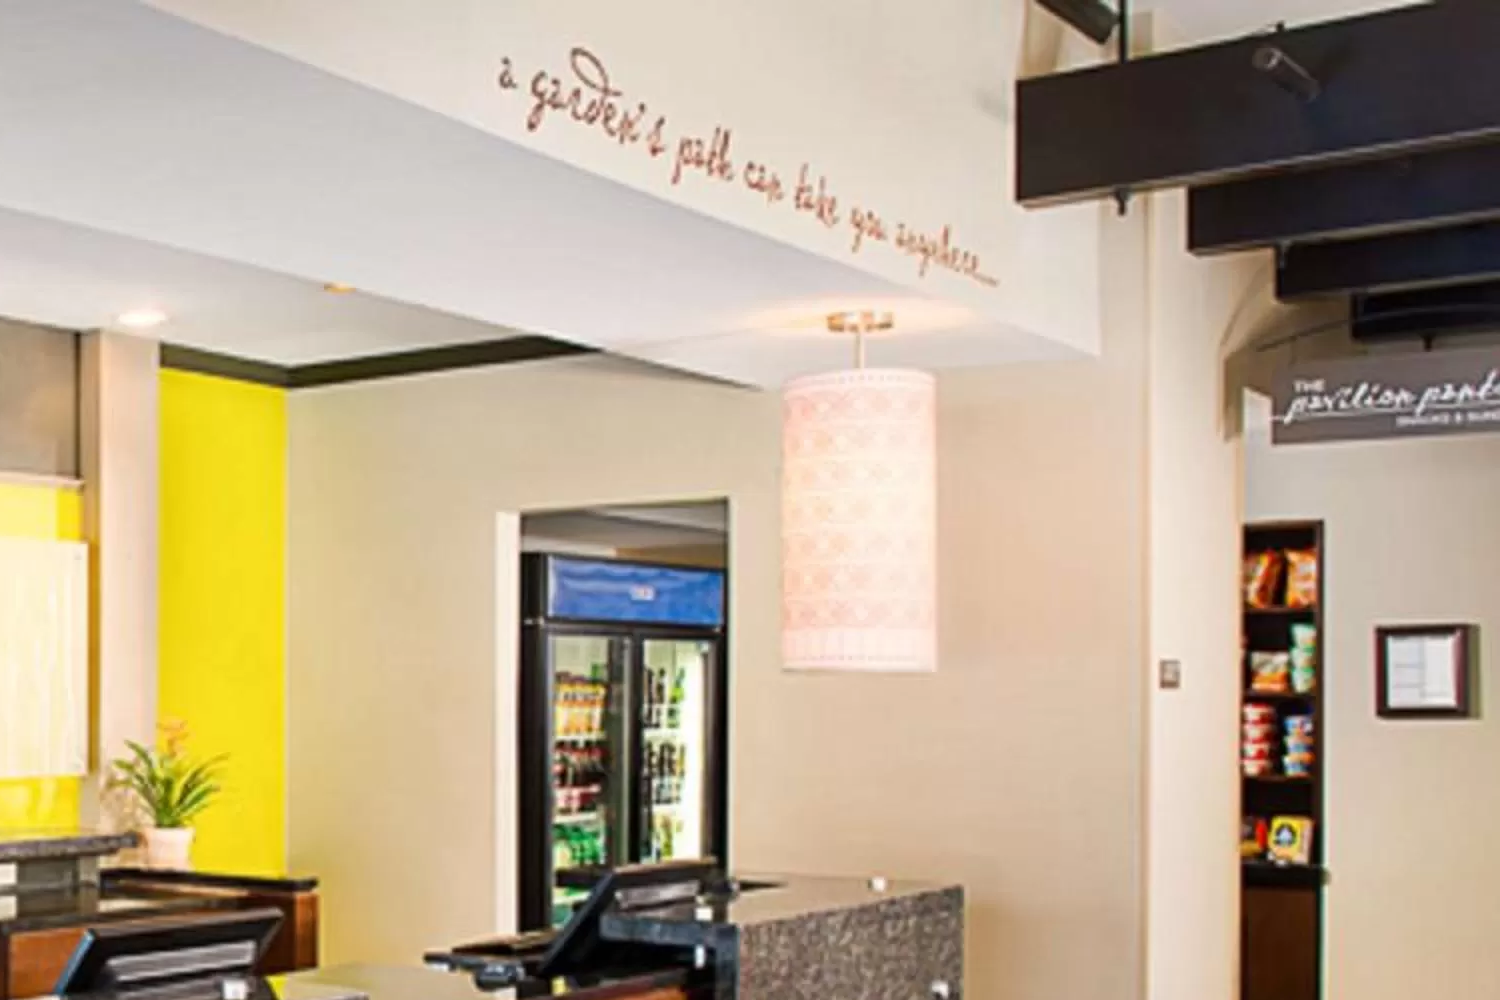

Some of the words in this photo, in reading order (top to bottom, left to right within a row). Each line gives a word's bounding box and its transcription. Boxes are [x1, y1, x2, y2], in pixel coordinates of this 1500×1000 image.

[499, 57, 518, 90] a
[526, 47, 667, 157] garden's
[671, 125, 734, 185] path
[743, 161, 784, 201] can
[794, 163, 840, 227] take
[1284, 381, 1414, 425] pavilion
[1293, 378, 1326, 393] THE
